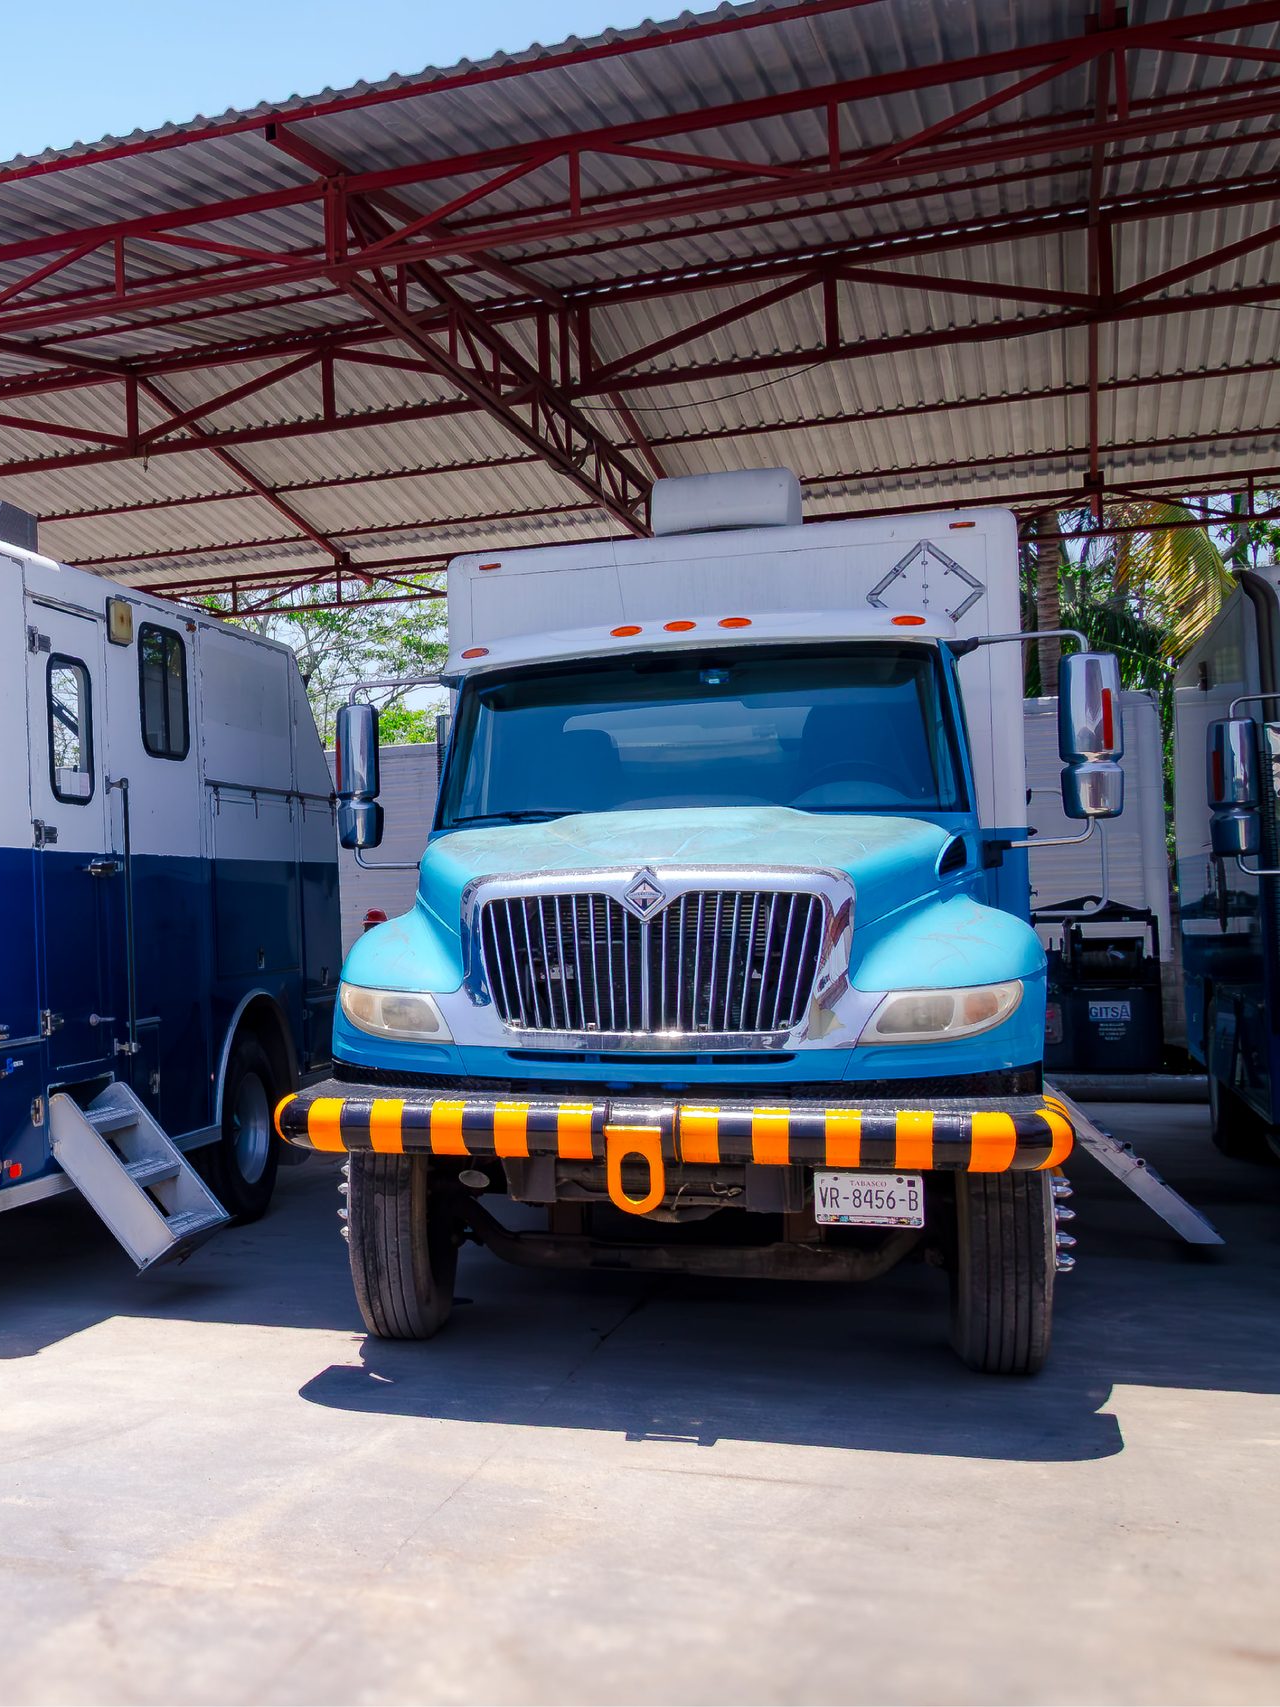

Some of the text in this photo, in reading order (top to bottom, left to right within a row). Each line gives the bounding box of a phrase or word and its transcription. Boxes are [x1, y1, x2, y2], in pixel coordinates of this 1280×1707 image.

[1089, 1004, 1130, 1019] GITSA
[849, 1180, 887, 1188] TABASCO
[819, 1187, 918, 1211] VR-8456-B
